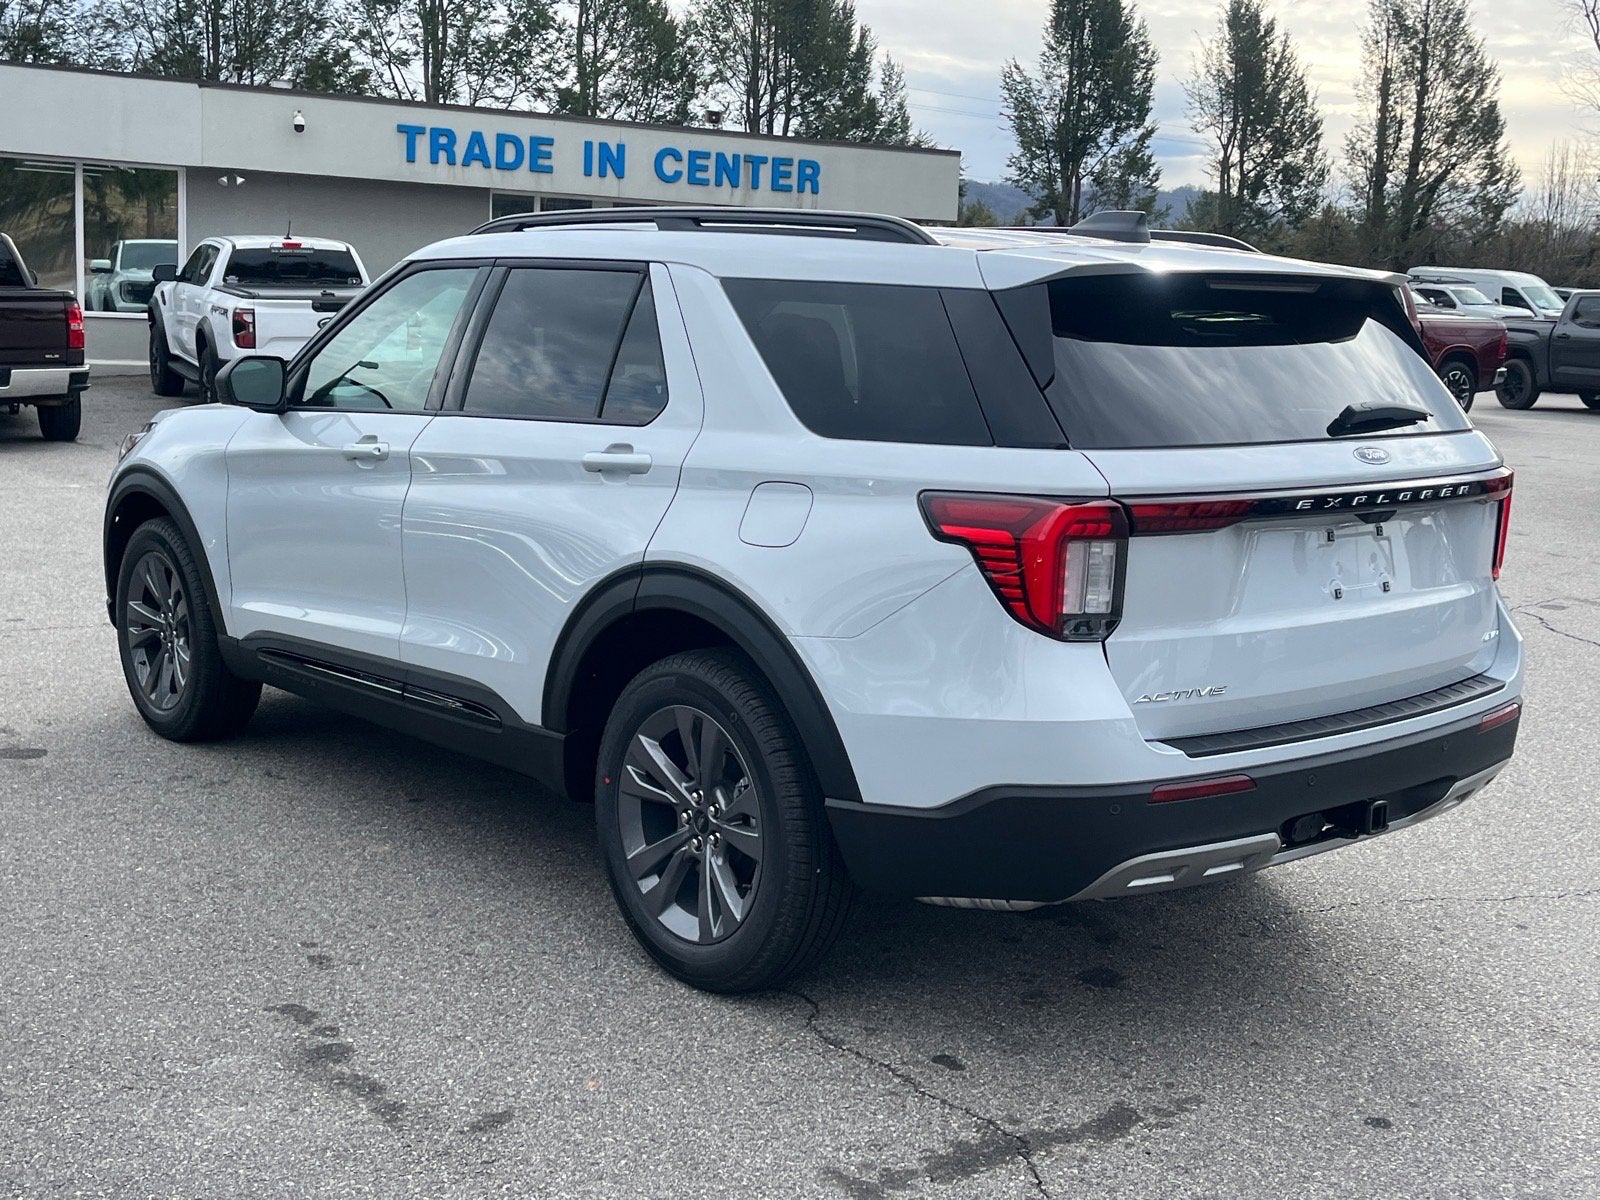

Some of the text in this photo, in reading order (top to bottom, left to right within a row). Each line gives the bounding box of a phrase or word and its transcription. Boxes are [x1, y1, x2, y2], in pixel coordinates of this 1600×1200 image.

[397, 124, 821, 195] TRADE IN CENTER
[1296, 485, 1470, 510] EXPLORER
[1133, 686, 1227, 704] ACTIVE
